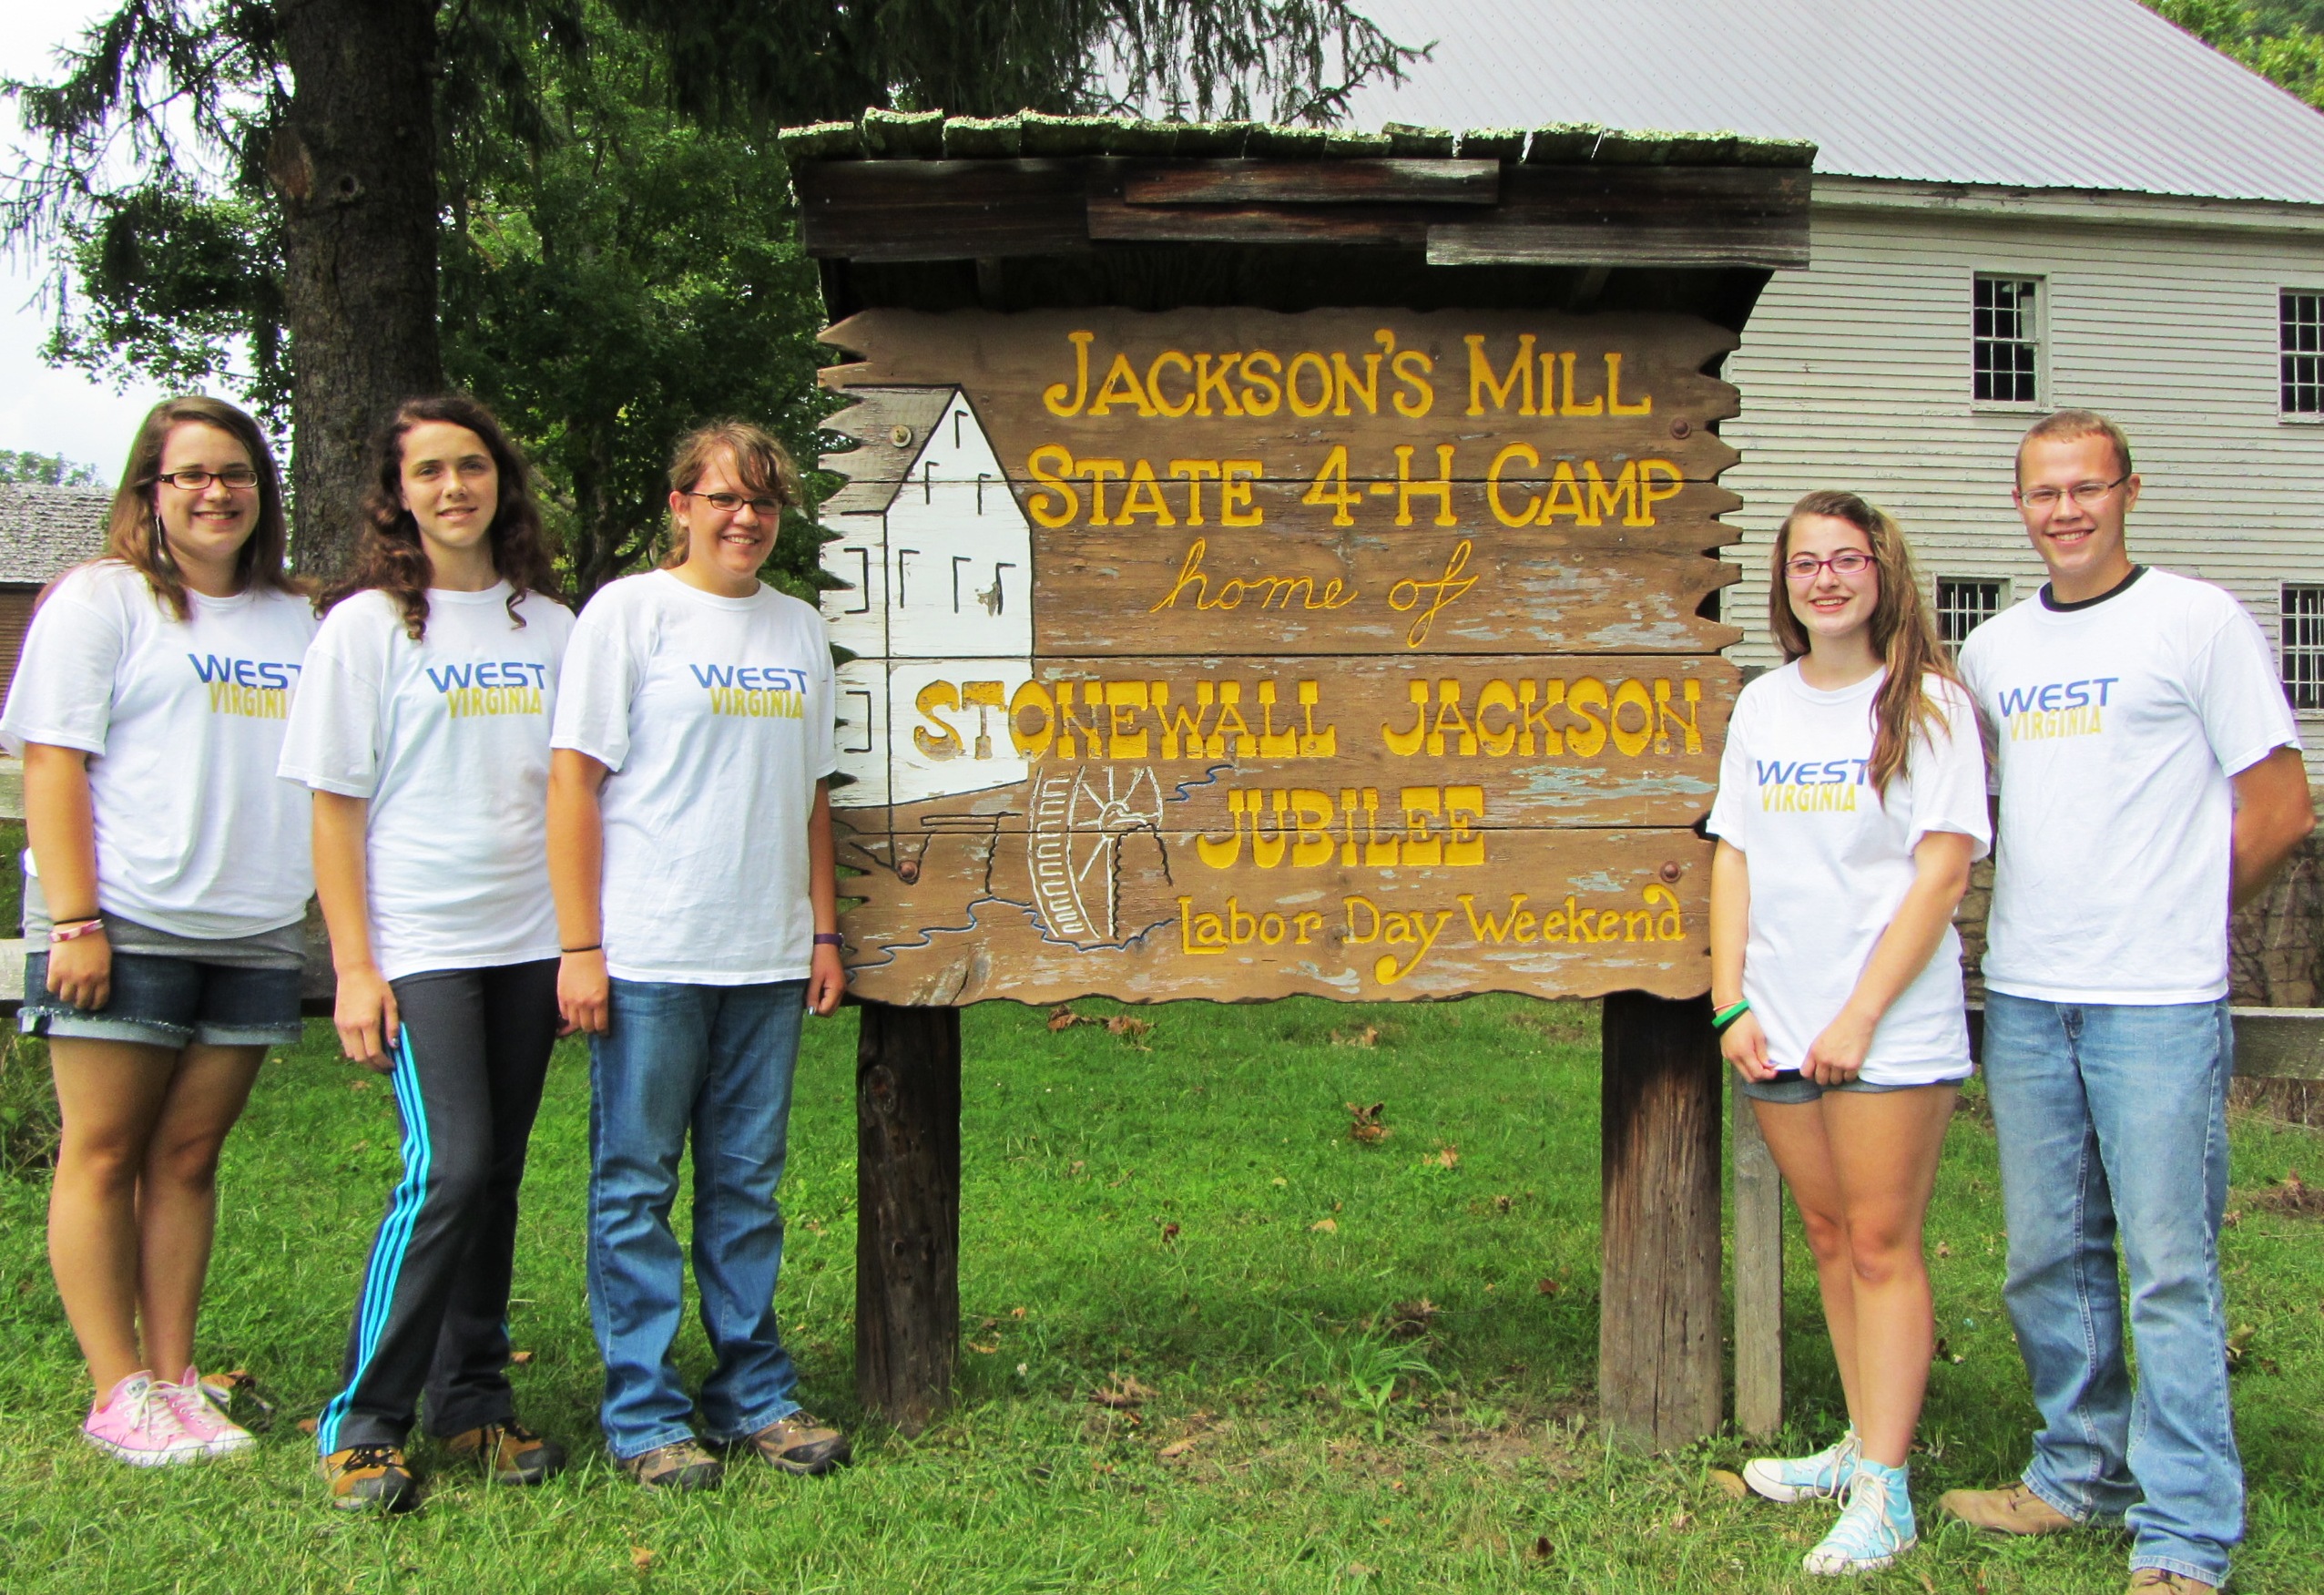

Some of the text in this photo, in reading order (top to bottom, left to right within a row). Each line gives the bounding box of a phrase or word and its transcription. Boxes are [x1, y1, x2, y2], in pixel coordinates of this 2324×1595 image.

[1043, 329, 1651, 417] JACKSON'S MILL
[1028, 442, 1684, 527] STATE 4-H CAMP
[1150, 537, 1479, 649] home of
[426, 661, 546, 693] WEST
[688, 664, 808, 695] WEST
[208, 680, 288, 720] VIRGINI
[445, 685, 543, 720] VIRGINIA
[708, 687, 804, 719] VIRGINIA
[1998, 677, 2119, 718] WEST
[913, 678, 1703, 760] STONEWALL JACKSON
[2009, 705, 2103, 741] VIRGINIA
[1756, 758, 1870, 786] WEST
[1761, 782, 1857, 813] VIRGINIA
[1195, 785, 1484, 869] JUBILEE
[1177, 883, 1687, 985] Labor Day Weekend
